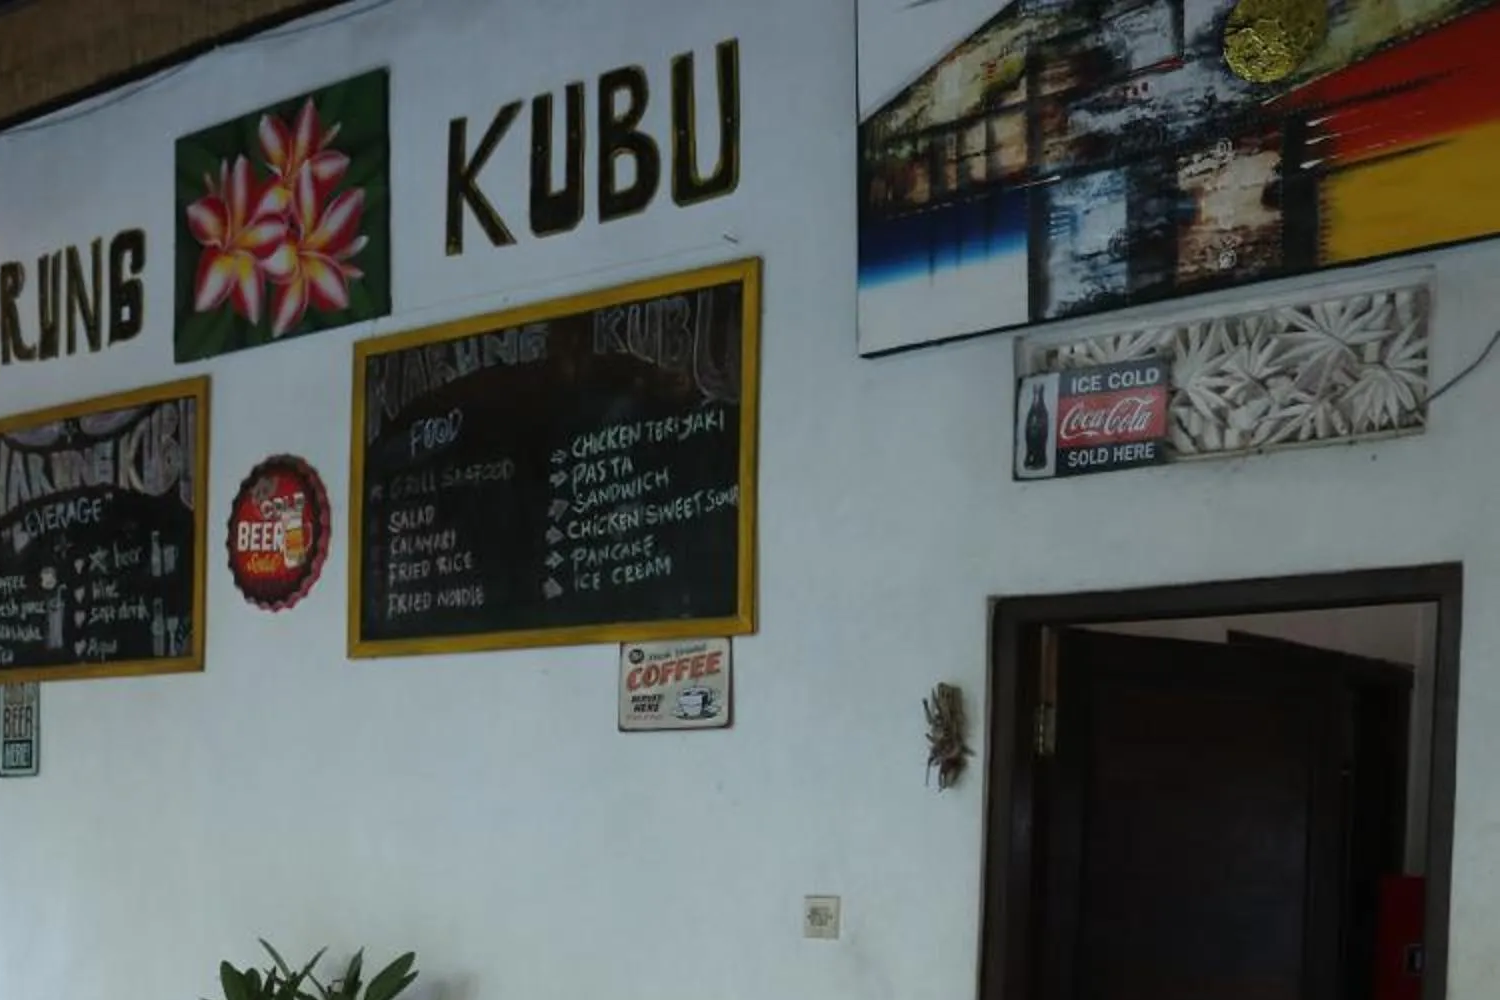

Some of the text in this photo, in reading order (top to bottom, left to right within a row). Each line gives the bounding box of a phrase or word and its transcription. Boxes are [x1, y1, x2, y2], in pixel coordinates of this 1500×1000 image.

[445, 37, 740, 256] KUBU
[367, 287, 740, 447] WARUNG KUBU
[1070, 368, 1160, 393] ICE COLD
[410, 407, 463, 458] FOOD
[571, 422, 641, 458] CHICKEN
[119, 399, 195, 511] KUBU
[1068, 443, 1155, 467] SOLD HERE
[571, 466, 670, 514] SANDWICH
[572, 456, 634, 495] PASTA
[388, 504, 435, 533] SALAD
[645, 490, 705, 525] SWEET
[237, 520, 285, 552] BEER
[570, 534, 655, 572] PANCAKE
[388, 551, 473, 588] FRIED RICE
[574, 555, 672, 592] ICE CREAM
[387, 592, 433, 620] FRIED
[626, 651, 723, 691] COFFEE
[4, 704, 33, 738] BEER
